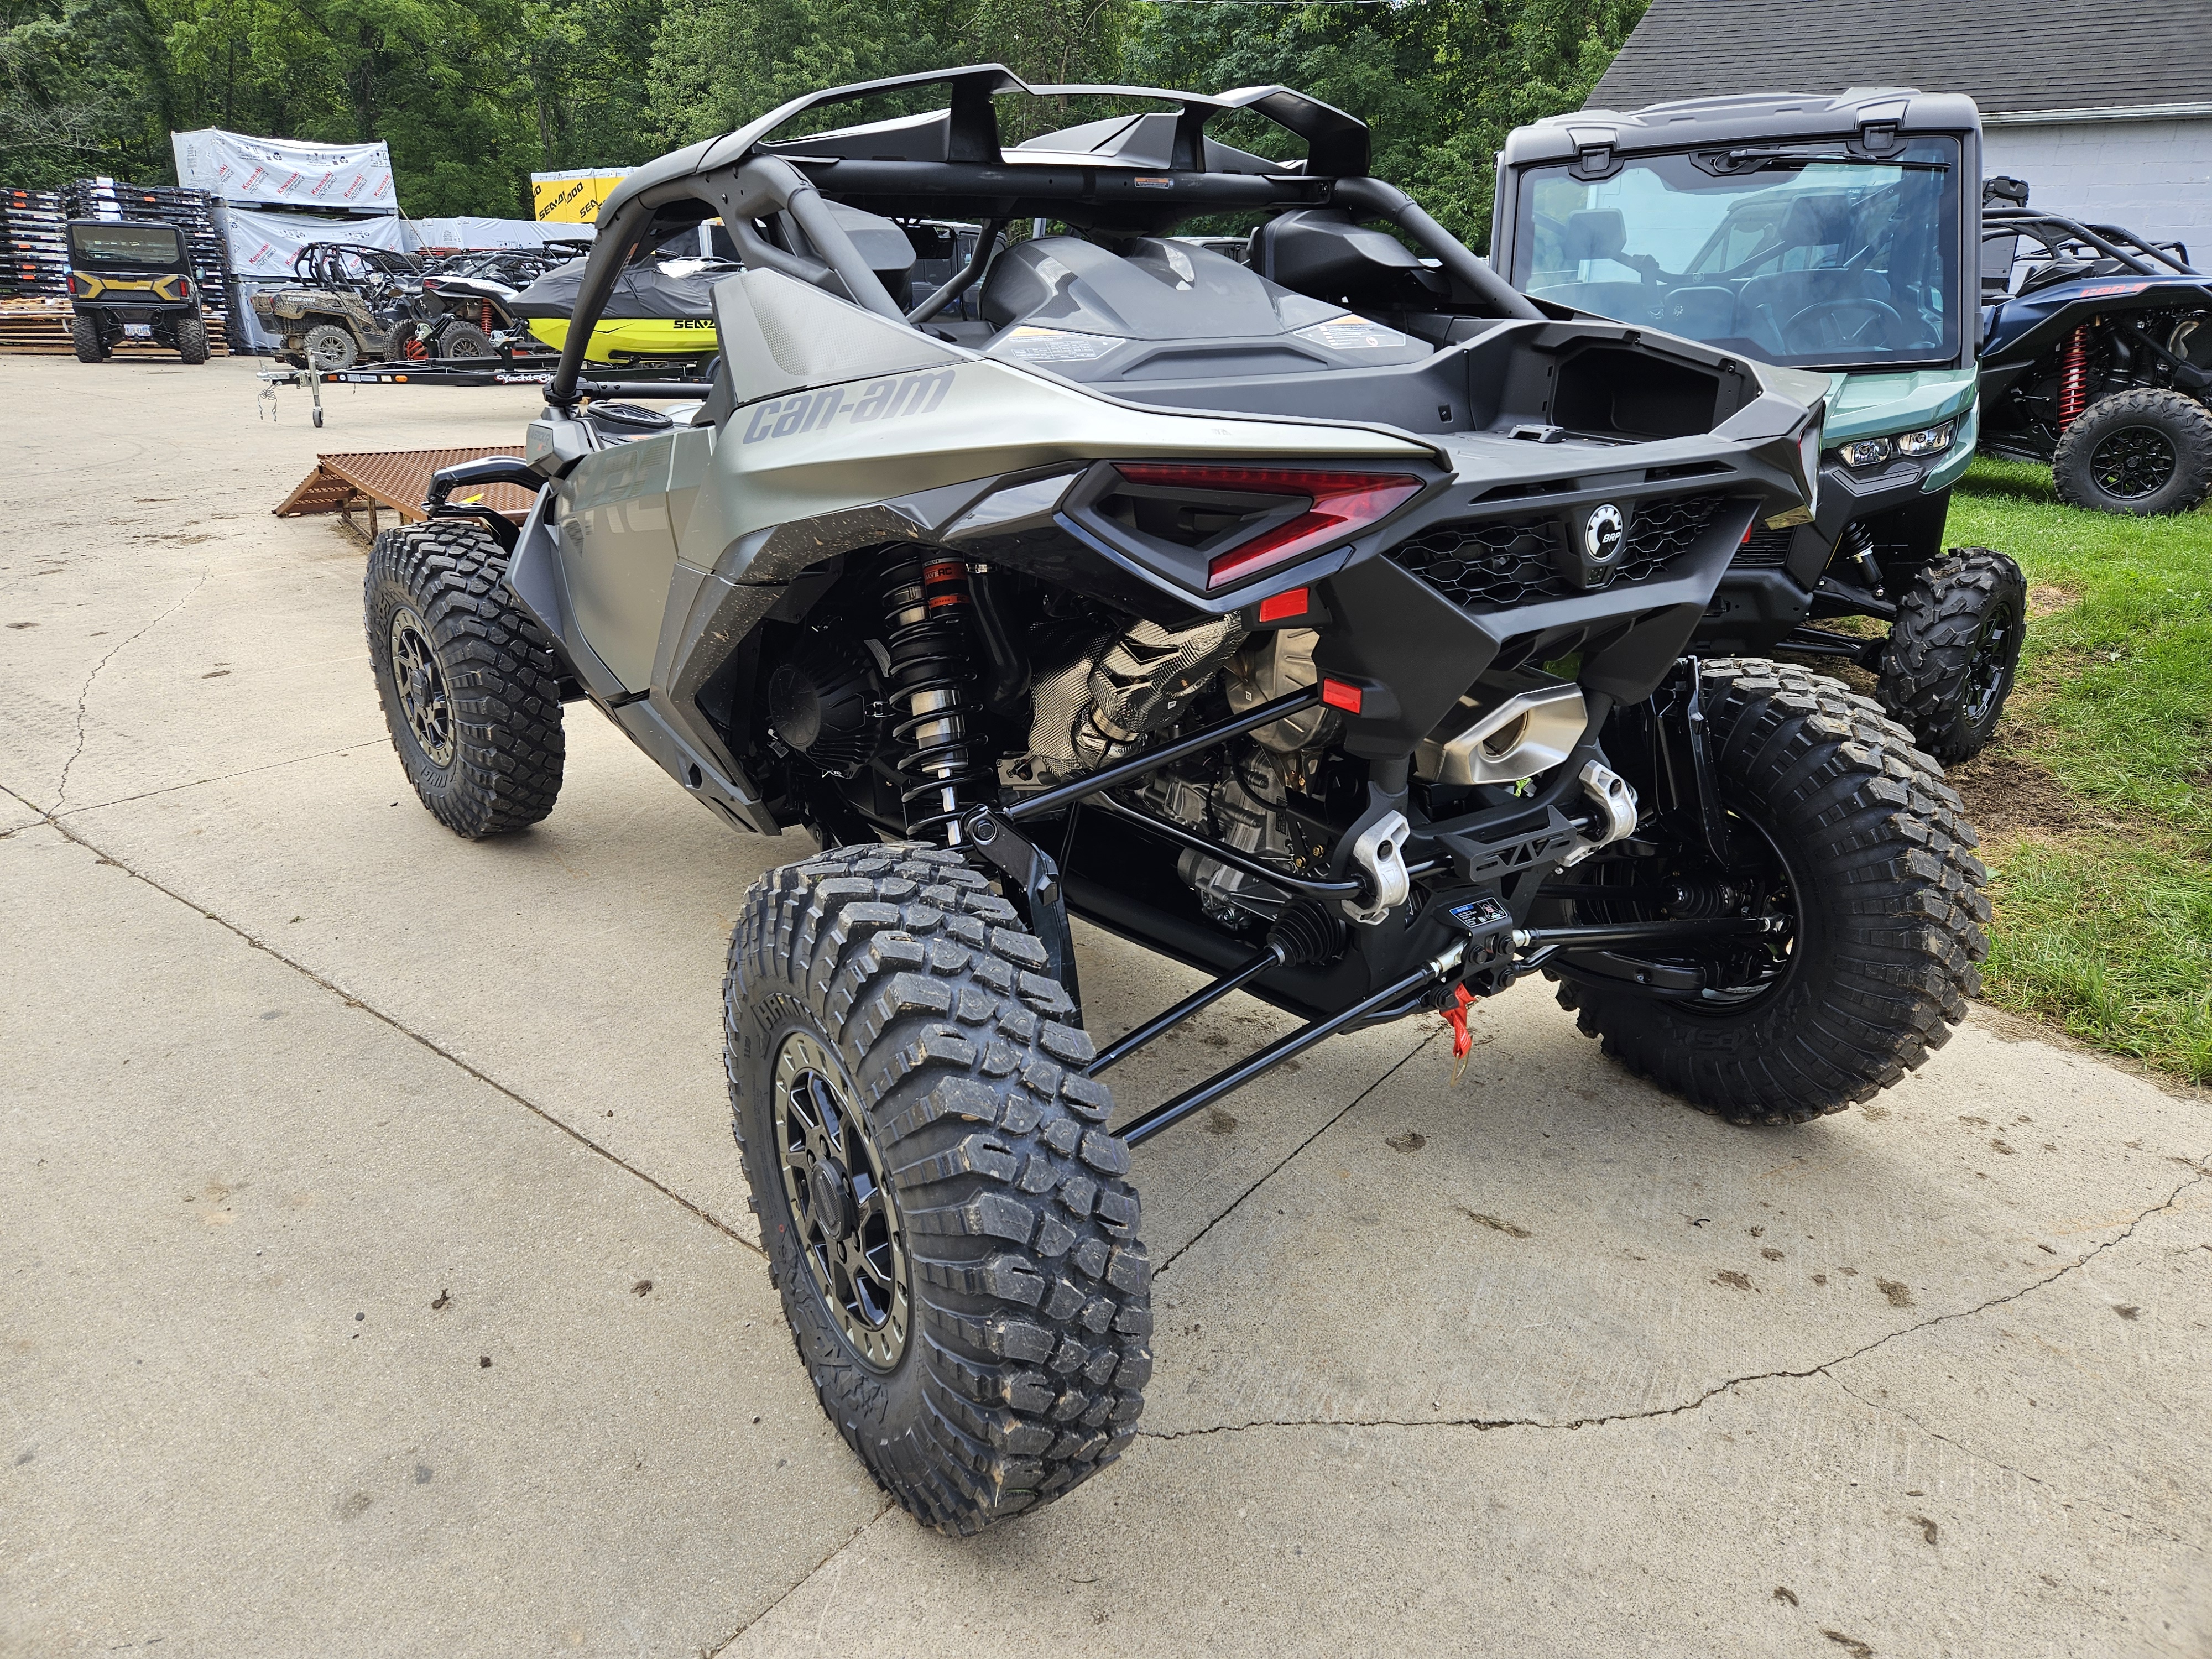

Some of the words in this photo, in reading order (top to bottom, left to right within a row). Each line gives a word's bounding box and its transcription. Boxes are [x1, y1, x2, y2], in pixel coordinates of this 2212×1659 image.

[241, 165, 264, 190] Kawasaki
[276, 170, 300, 194] Kawasaki
[311, 170, 333, 195] Kawasaki
[343, 173, 363, 198] Kawasaki
[373, 172, 392, 197] Kawasaki
[248, 242, 270, 264] Kawasaki
[2080, 283, 2148, 298] can-a
[742, 369, 956, 444] can-am
[1602, 532, 1621, 543] BRP
